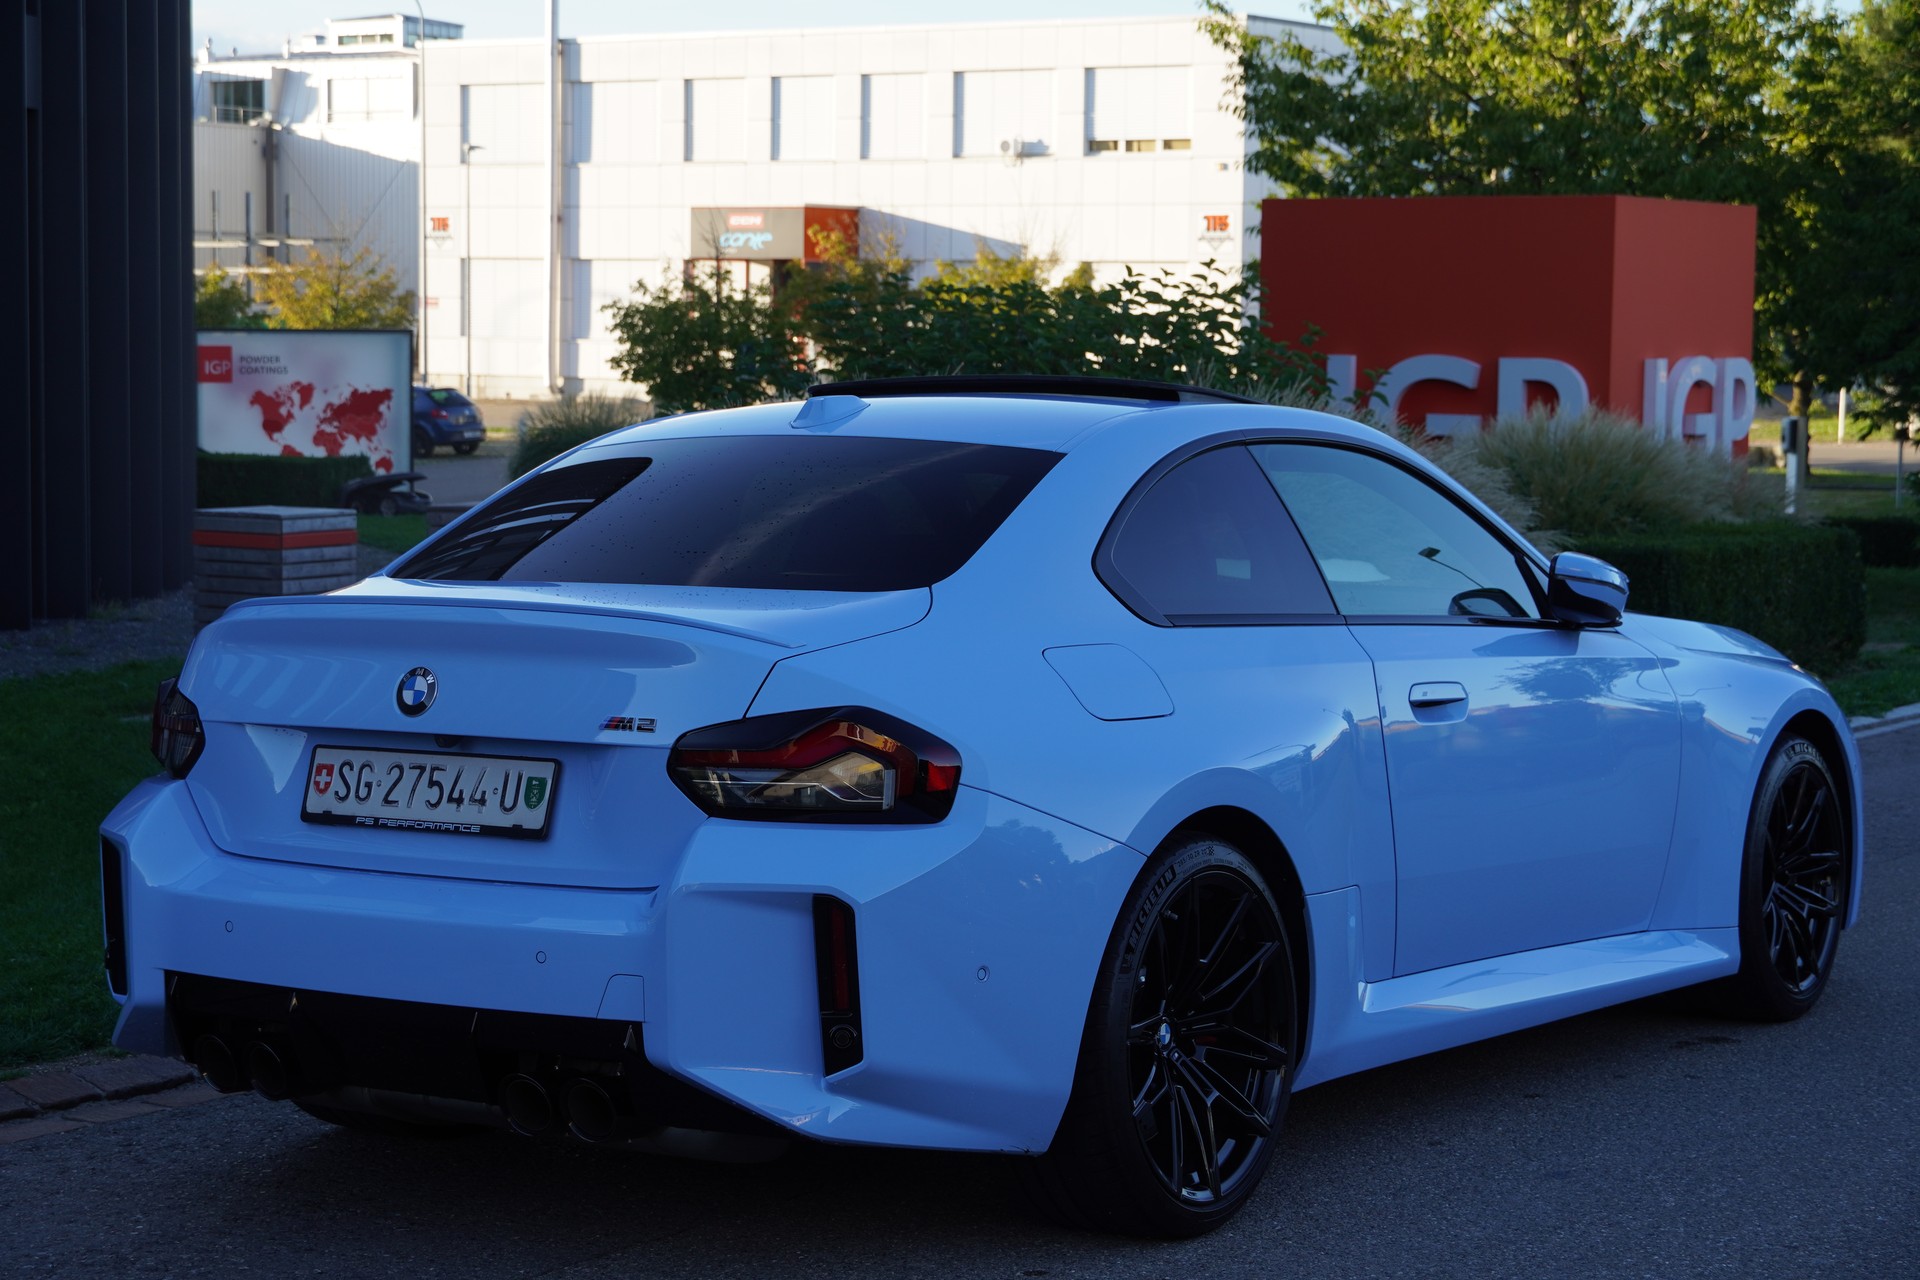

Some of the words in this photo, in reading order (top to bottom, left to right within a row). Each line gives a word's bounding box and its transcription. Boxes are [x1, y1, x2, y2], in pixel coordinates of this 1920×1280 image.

[204, 360, 232, 375] IGP
[239, 355, 281, 364] POWDER
[239, 366, 288, 375] COATINGS
[1643, 356, 1756, 462] IGP
[601, 716, 657, 733] M2
[355, 817, 375, 825] PS
[378, 818, 481, 833] PERFORMANCE
[1128, 866, 1176, 946] MICHELIN
